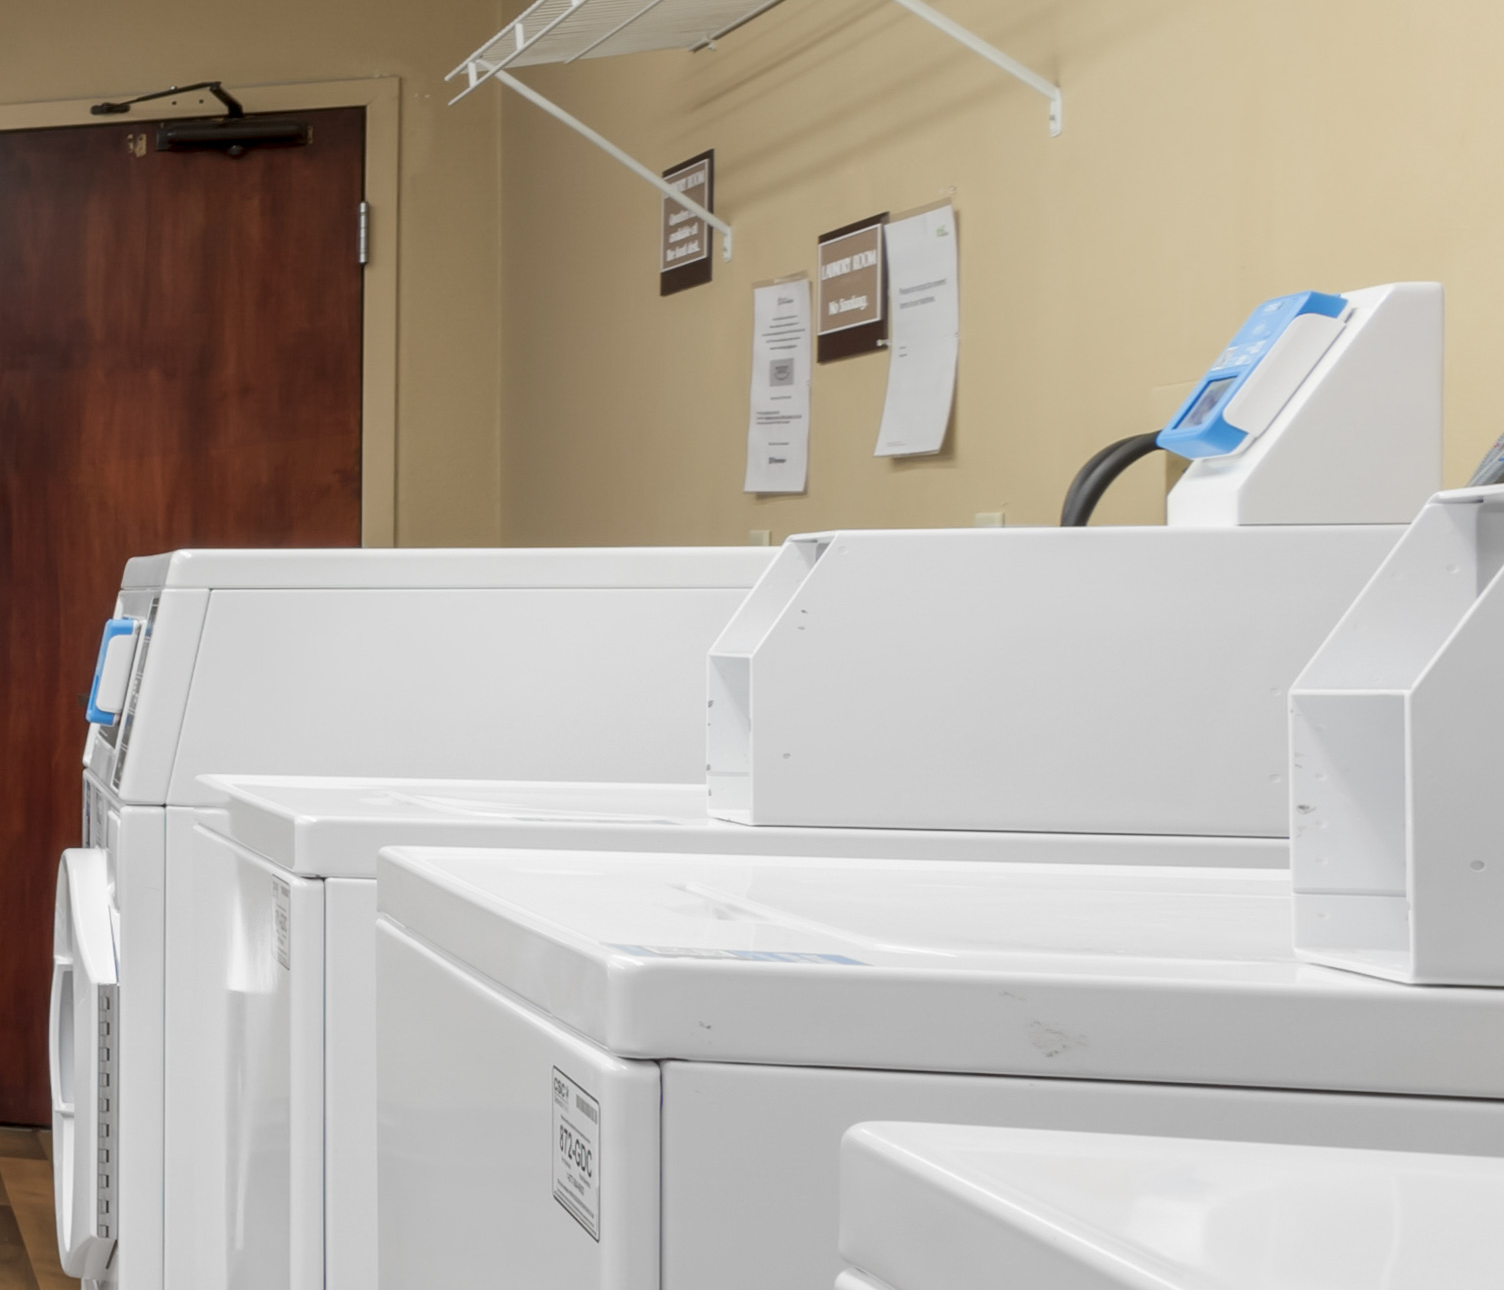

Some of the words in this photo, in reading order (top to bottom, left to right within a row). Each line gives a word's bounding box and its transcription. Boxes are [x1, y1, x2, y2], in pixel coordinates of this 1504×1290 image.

[821, 257, 851, 281] LAUNDRY
[852, 249, 877, 271] ROOM
[559, 1124, 593, 1178] 872-GDC
